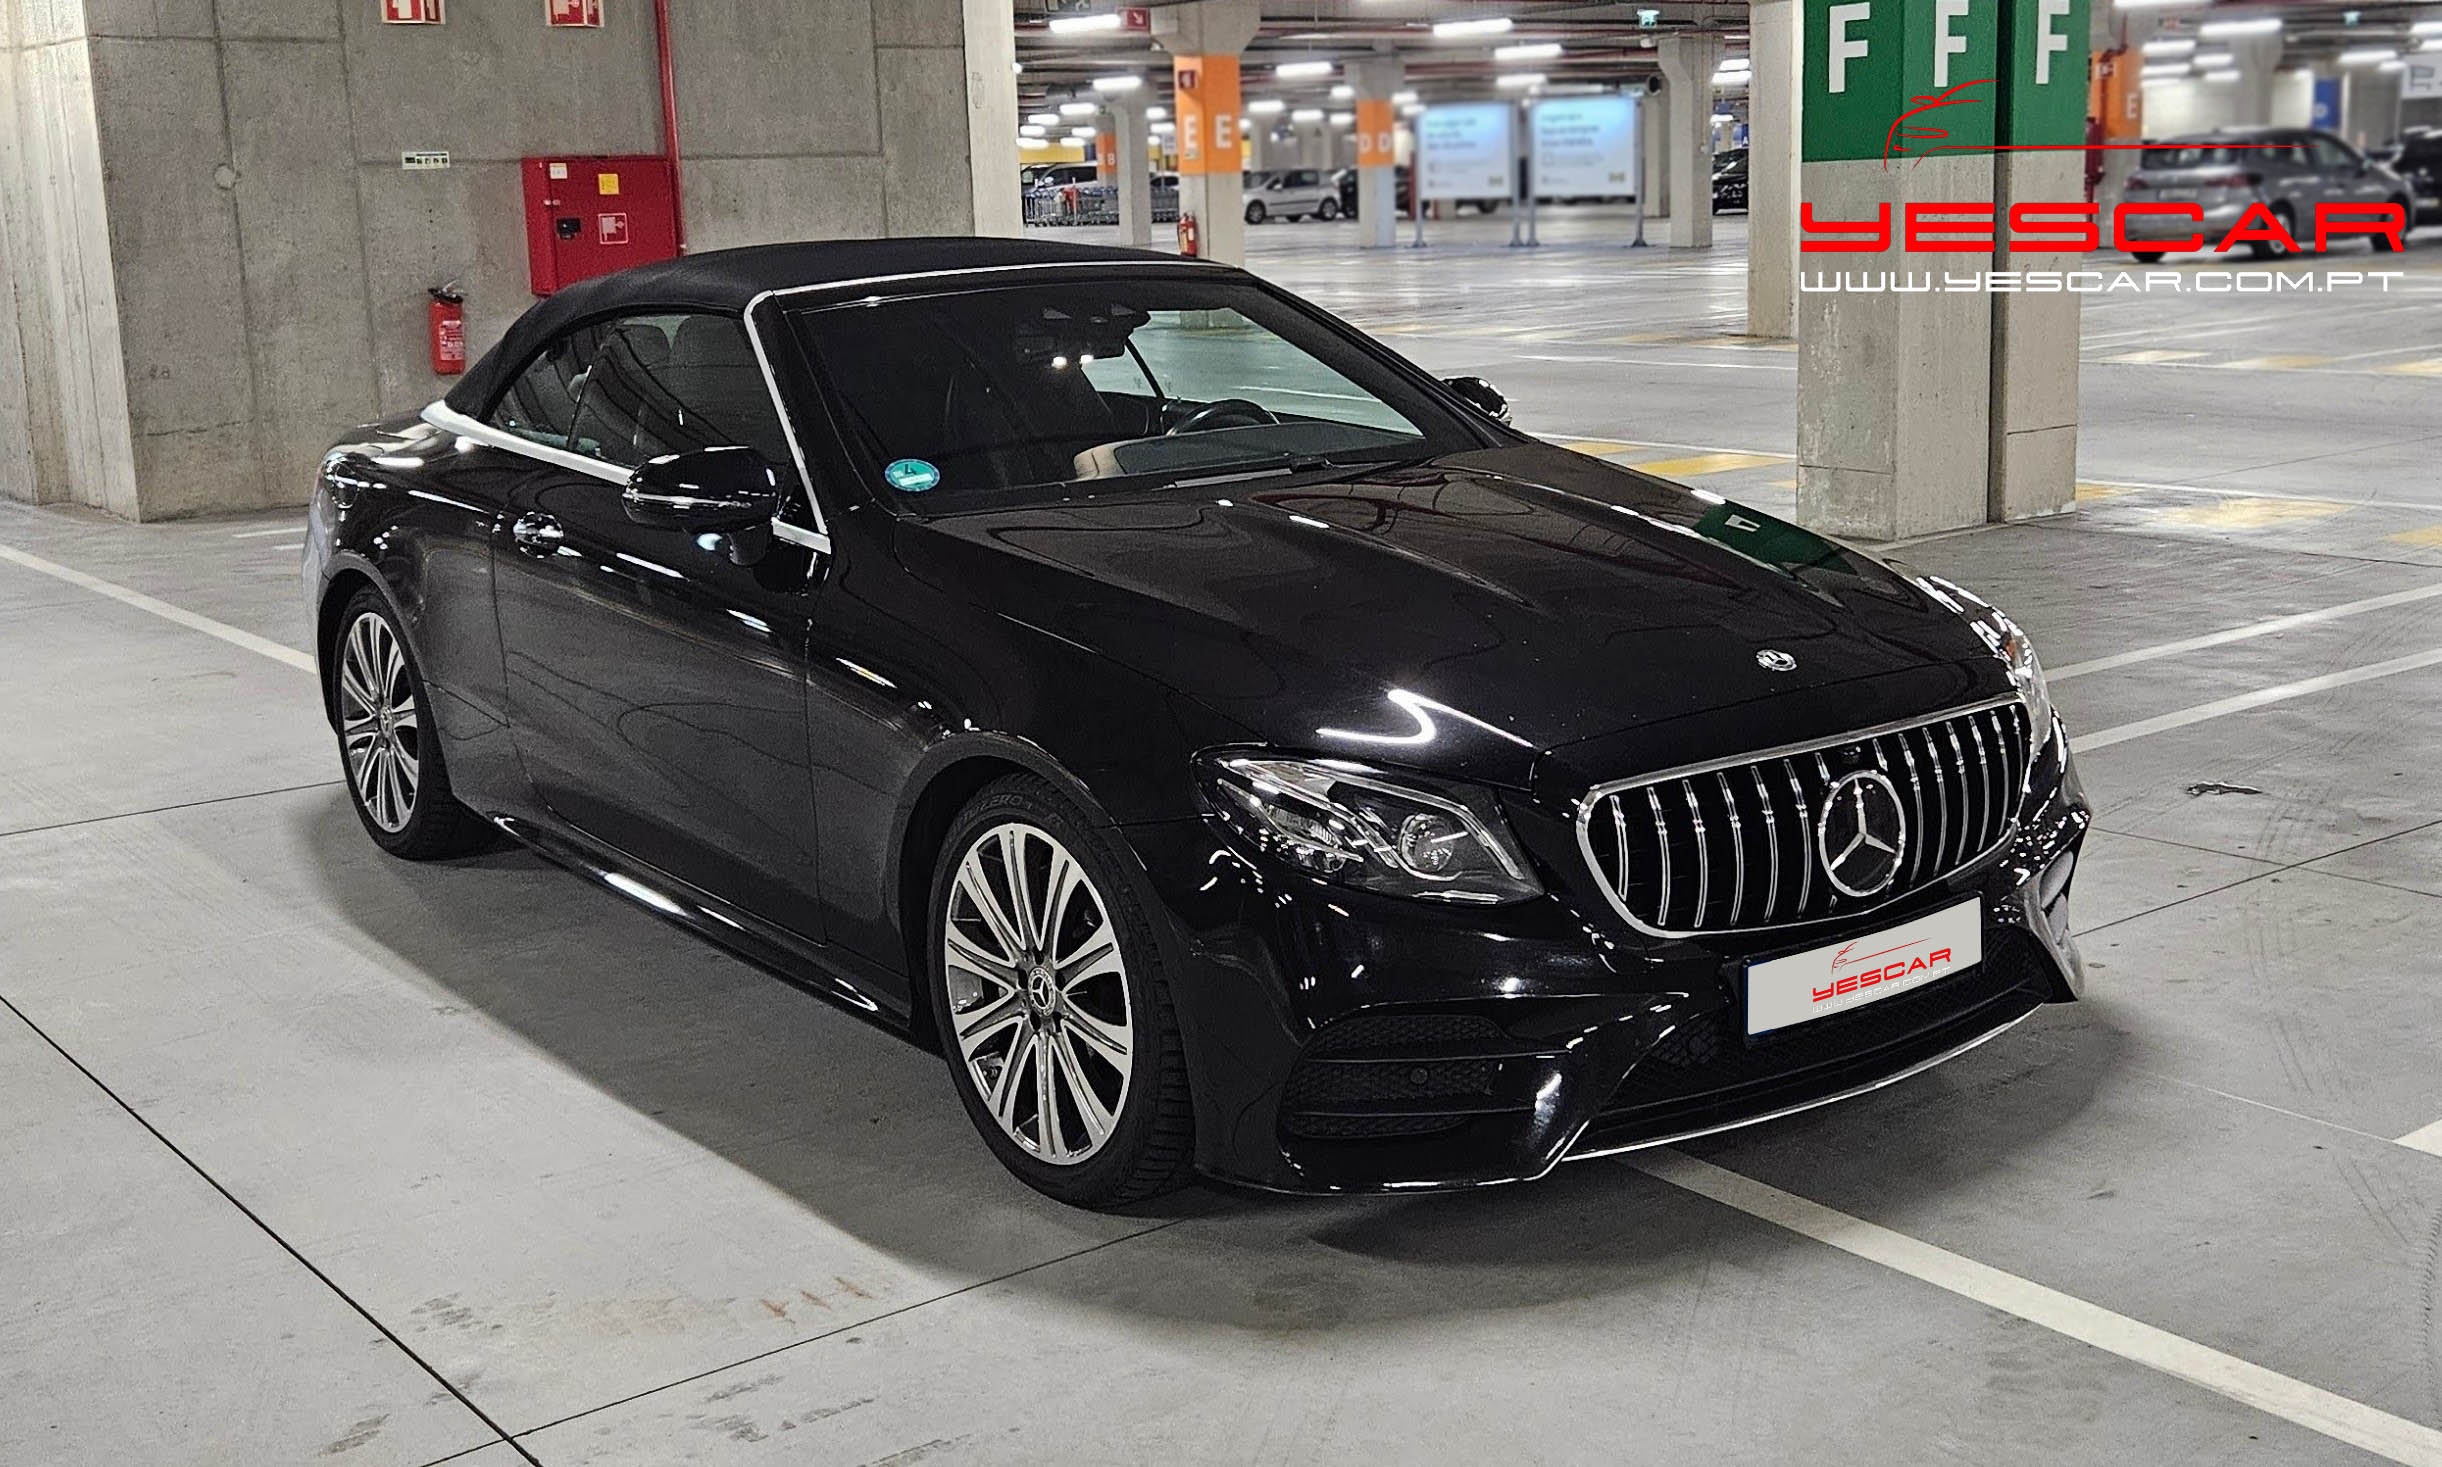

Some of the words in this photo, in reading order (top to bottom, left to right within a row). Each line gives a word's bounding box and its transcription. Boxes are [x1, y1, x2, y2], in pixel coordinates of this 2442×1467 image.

[1828, 2, 1870, 93] F
[1934, 0, 1969, 87] F
[2035, 0, 2070, 84] F
[1183, 114, 1198, 149] E
[1215, 114, 1232, 149] E
[2126, 93, 2137, 118] E
